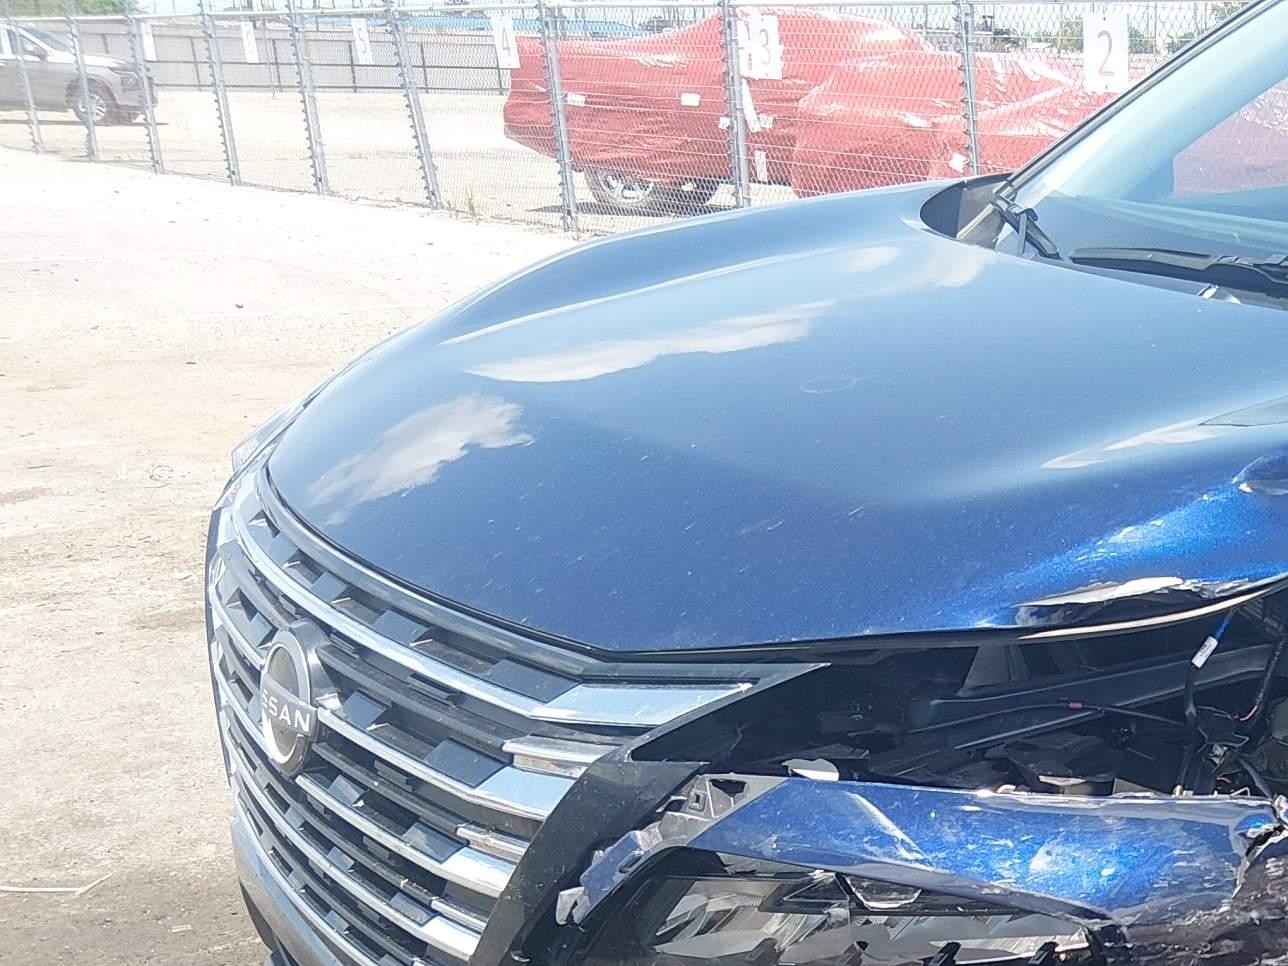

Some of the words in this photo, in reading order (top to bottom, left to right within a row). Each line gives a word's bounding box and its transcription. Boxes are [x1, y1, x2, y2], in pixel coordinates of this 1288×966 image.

[501, 27, 512, 57] 4
[758, 28, 772, 65] 3
[1097, 30, 1115, 77] 2
